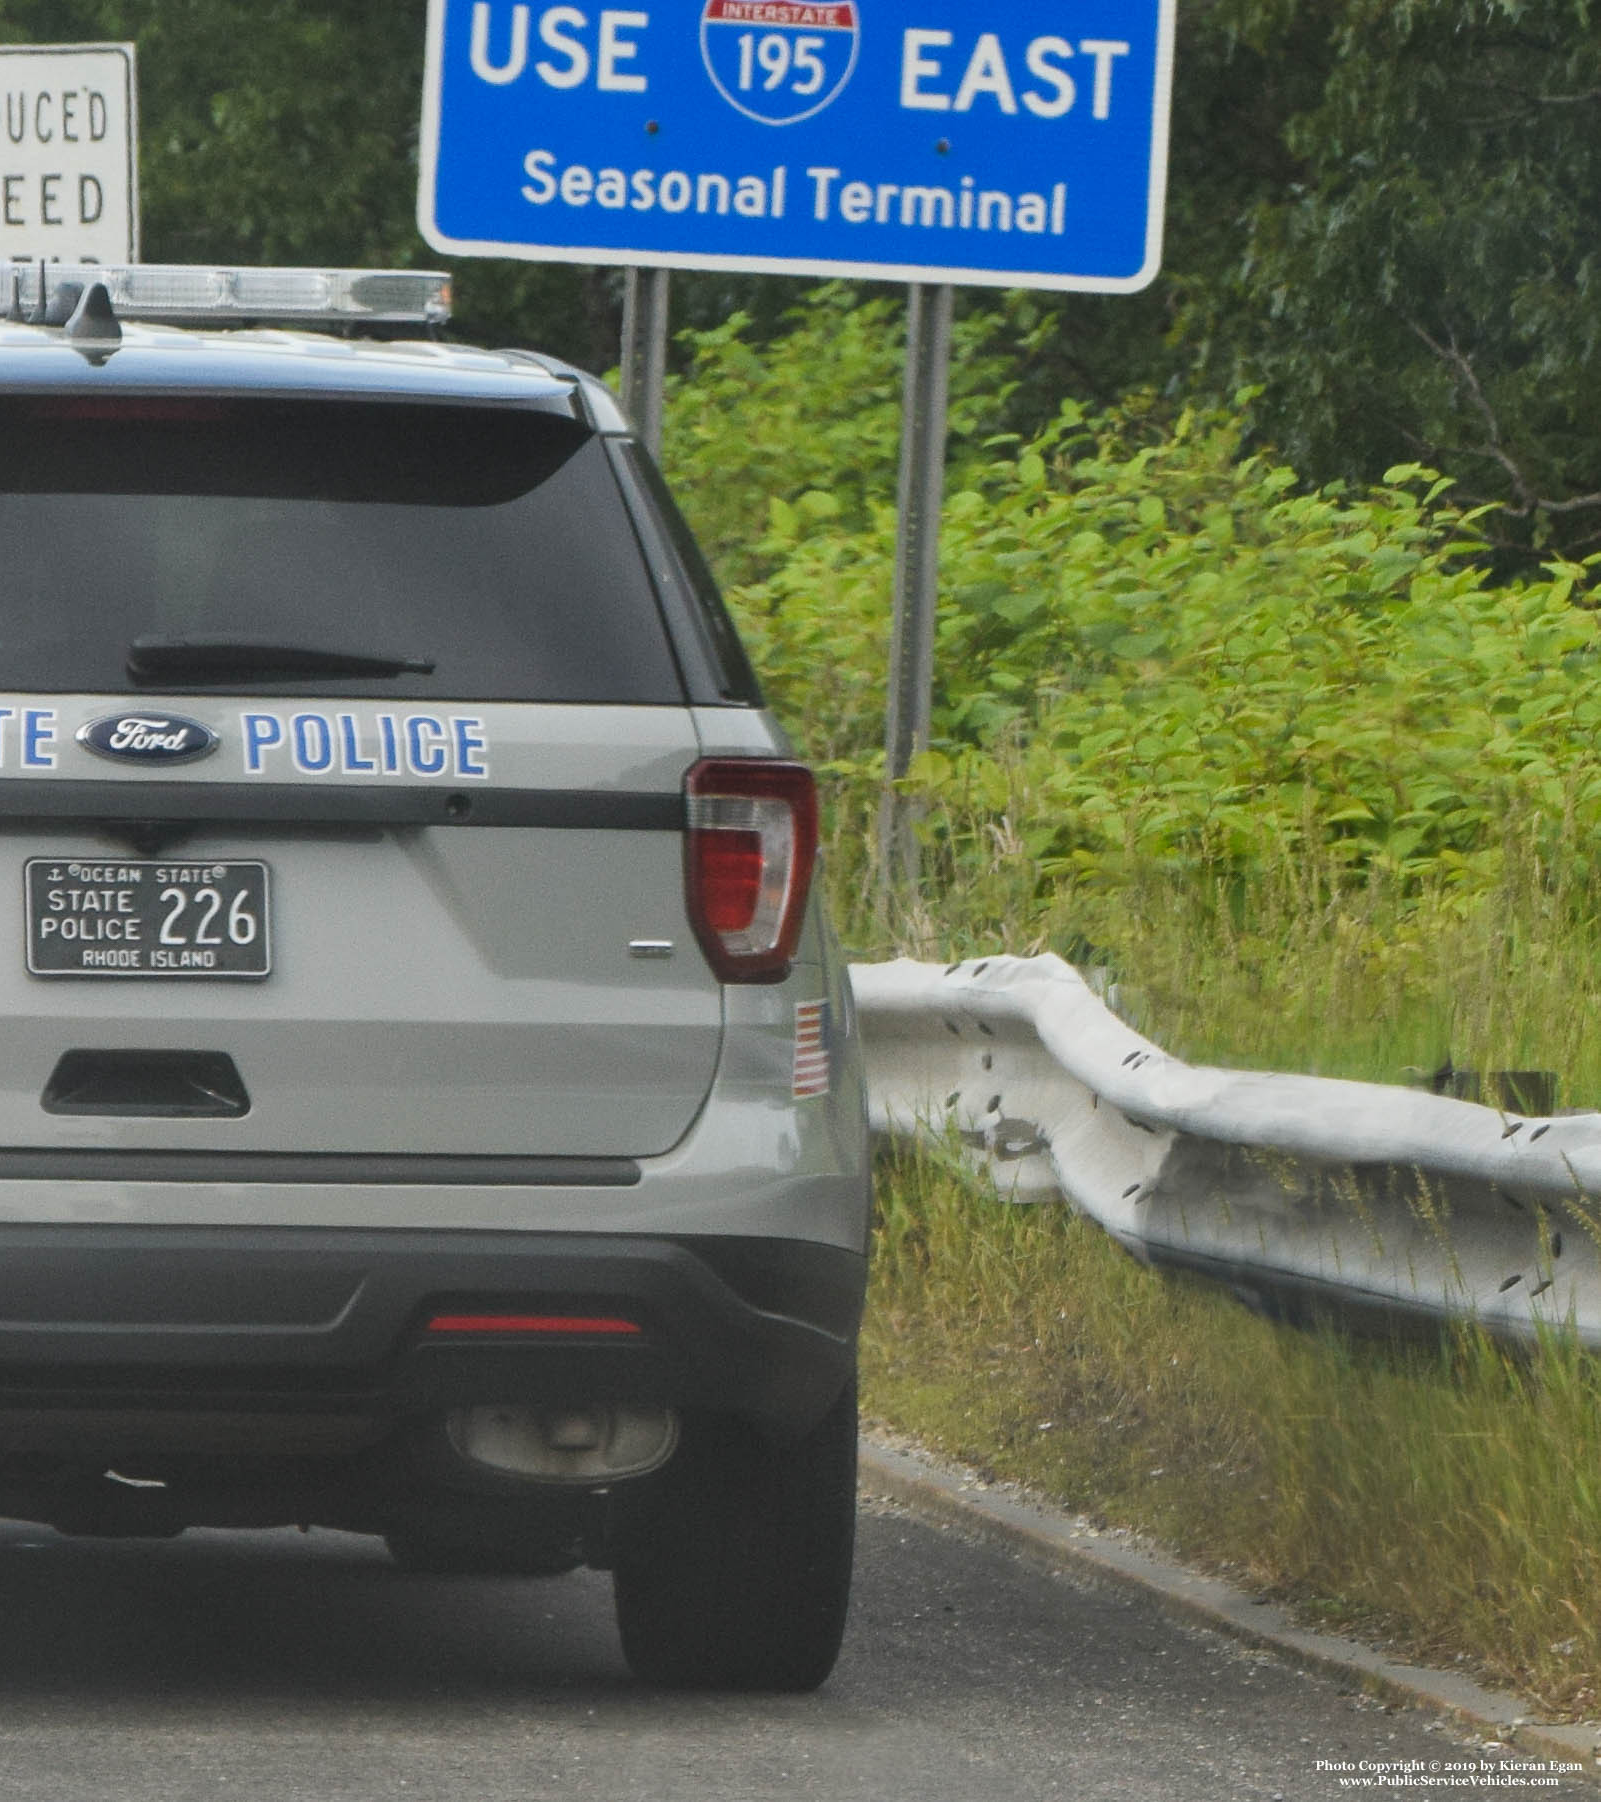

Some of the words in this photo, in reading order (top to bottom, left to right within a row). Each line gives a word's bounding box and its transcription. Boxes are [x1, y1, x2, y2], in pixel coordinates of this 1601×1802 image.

[722, 2, 838, 25] INTERSTATE
[469, 1, 649, 93] USE
[738, 34, 825, 95] 195
[900, 27, 1130, 120] EAST
[521, 149, 787, 219] Seasonal
[806, 167, 1067, 235] Terminal
[109, 718, 189, 751] Ford
[241, 712, 489, 779] POLICE
[80, 866, 142, 883] OCEAN
[156, 868, 213, 884] STATE
[48, 889, 134, 913] STATE
[159, 887, 256, 945] 226
[40, 917, 142, 941] POLICE
[82, 950, 142, 968] RHODE
[150, 951, 215, 968] ISLAND
